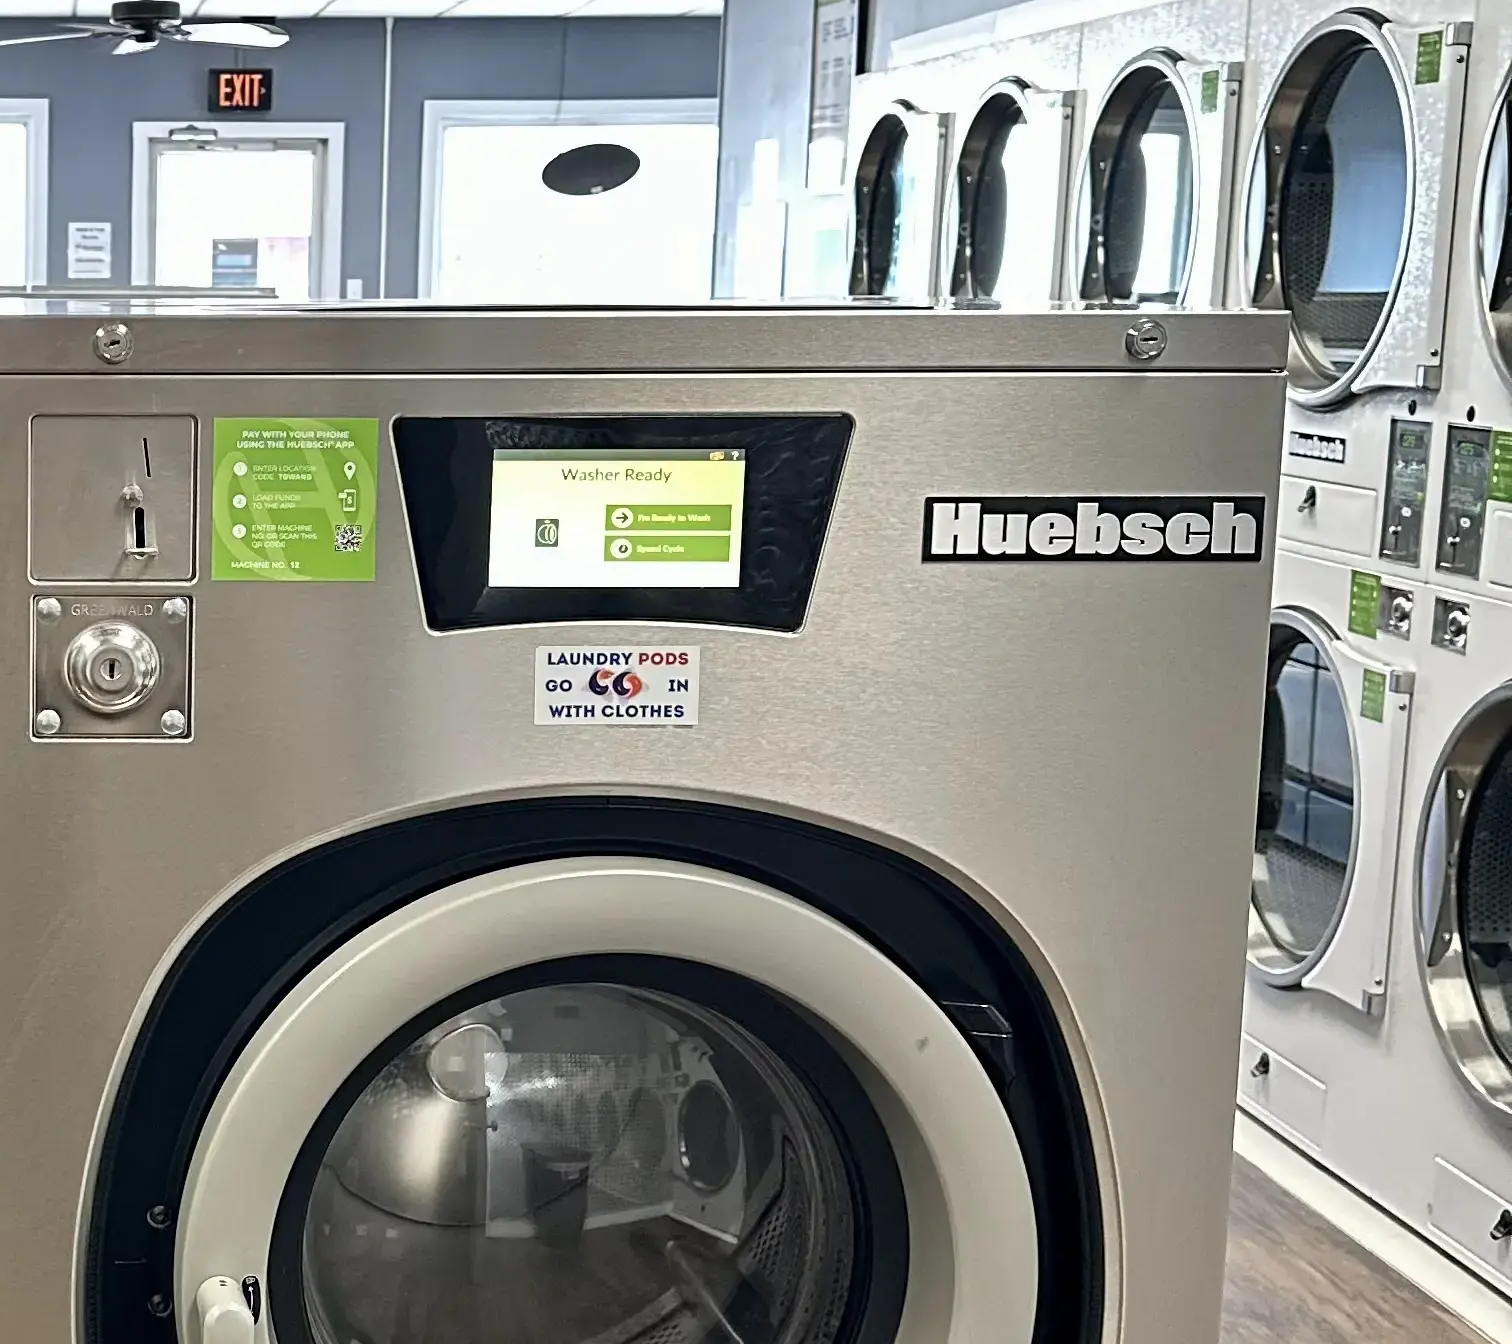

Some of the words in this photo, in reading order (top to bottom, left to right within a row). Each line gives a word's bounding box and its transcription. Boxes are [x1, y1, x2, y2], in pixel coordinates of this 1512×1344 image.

[219, 74, 263, 107] EXIT
[242, 430, 260, 438] PAY
[262, 430, 286, 438] WITH
[288, 430, 314, 438] YOUR
[316, 430, 350, 438] PHONE
[236, 440, 266, 448] USING
[266, 440, 284, 448] THE
[561, 468, 620, 482] Washer
[625, 468, 672, 483] Ready
[252, 524, 276, 532] ENTER
[278, 524, 313, 532] MACHINE
[930, 502, 1257, 555] Huebsch
[266, 532, 278, 540] OR
[279, 532, 299, 540] SCAN
[300, 532, 317, 540] THIS
[71, 604, 154, 616] GREENWALD
[547, 652, 633, 665] LAUNDRY
[638, 652, 689, 665] PODS
[545, 680, 572, 692] GO
[668, 679, 689, 692] IN
[549, 704, 595, 718] WITH
[601, 704, 684, 718] CLOTHES
